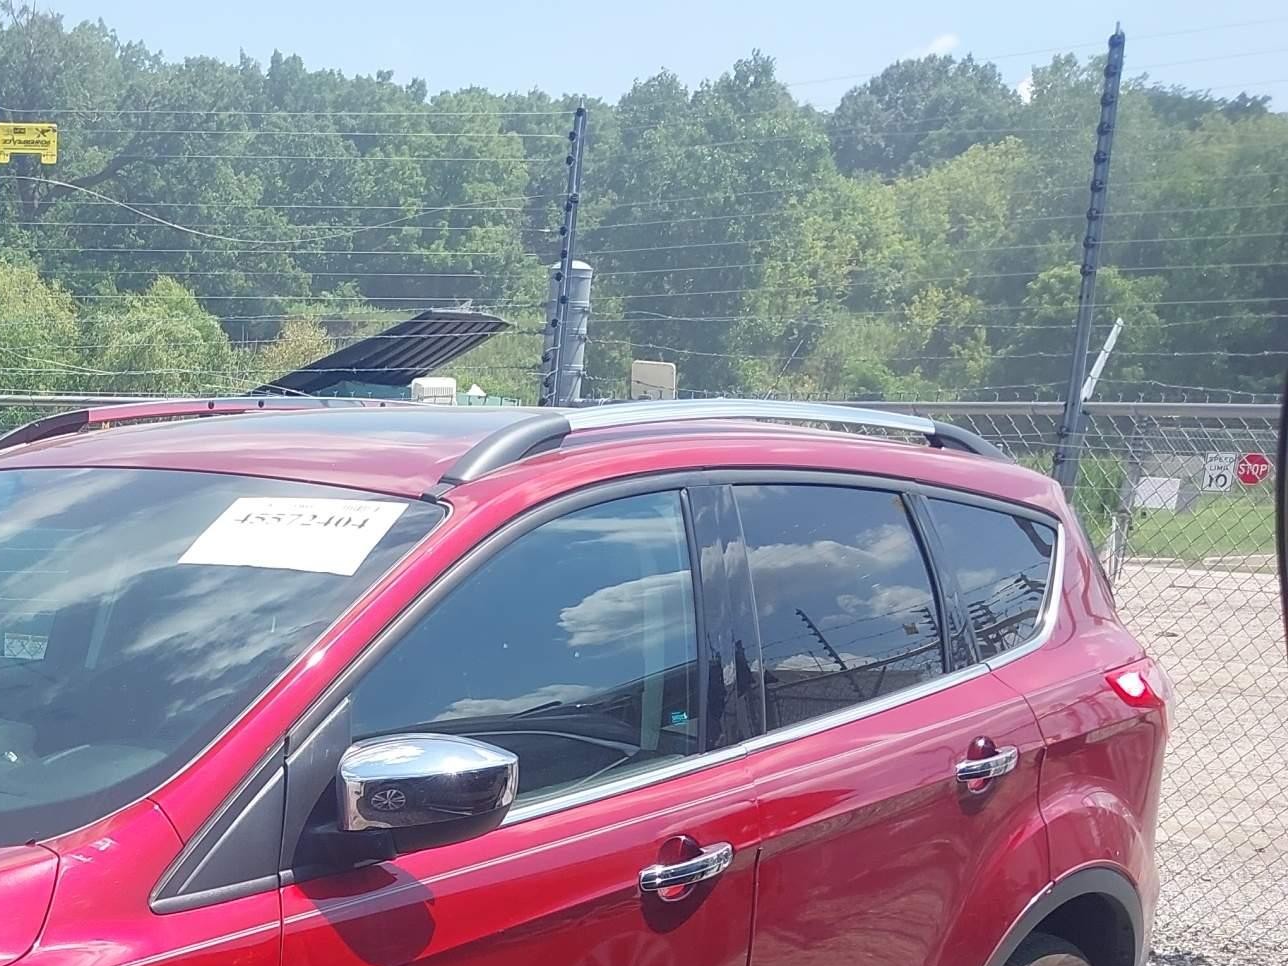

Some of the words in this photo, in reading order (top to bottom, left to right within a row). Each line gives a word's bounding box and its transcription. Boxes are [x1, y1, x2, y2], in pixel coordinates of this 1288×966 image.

[1239, 464, 1267, 475] STOP
[1209, 474, 1227, 487] 10
[234, 513, 370, 529] 45572404
